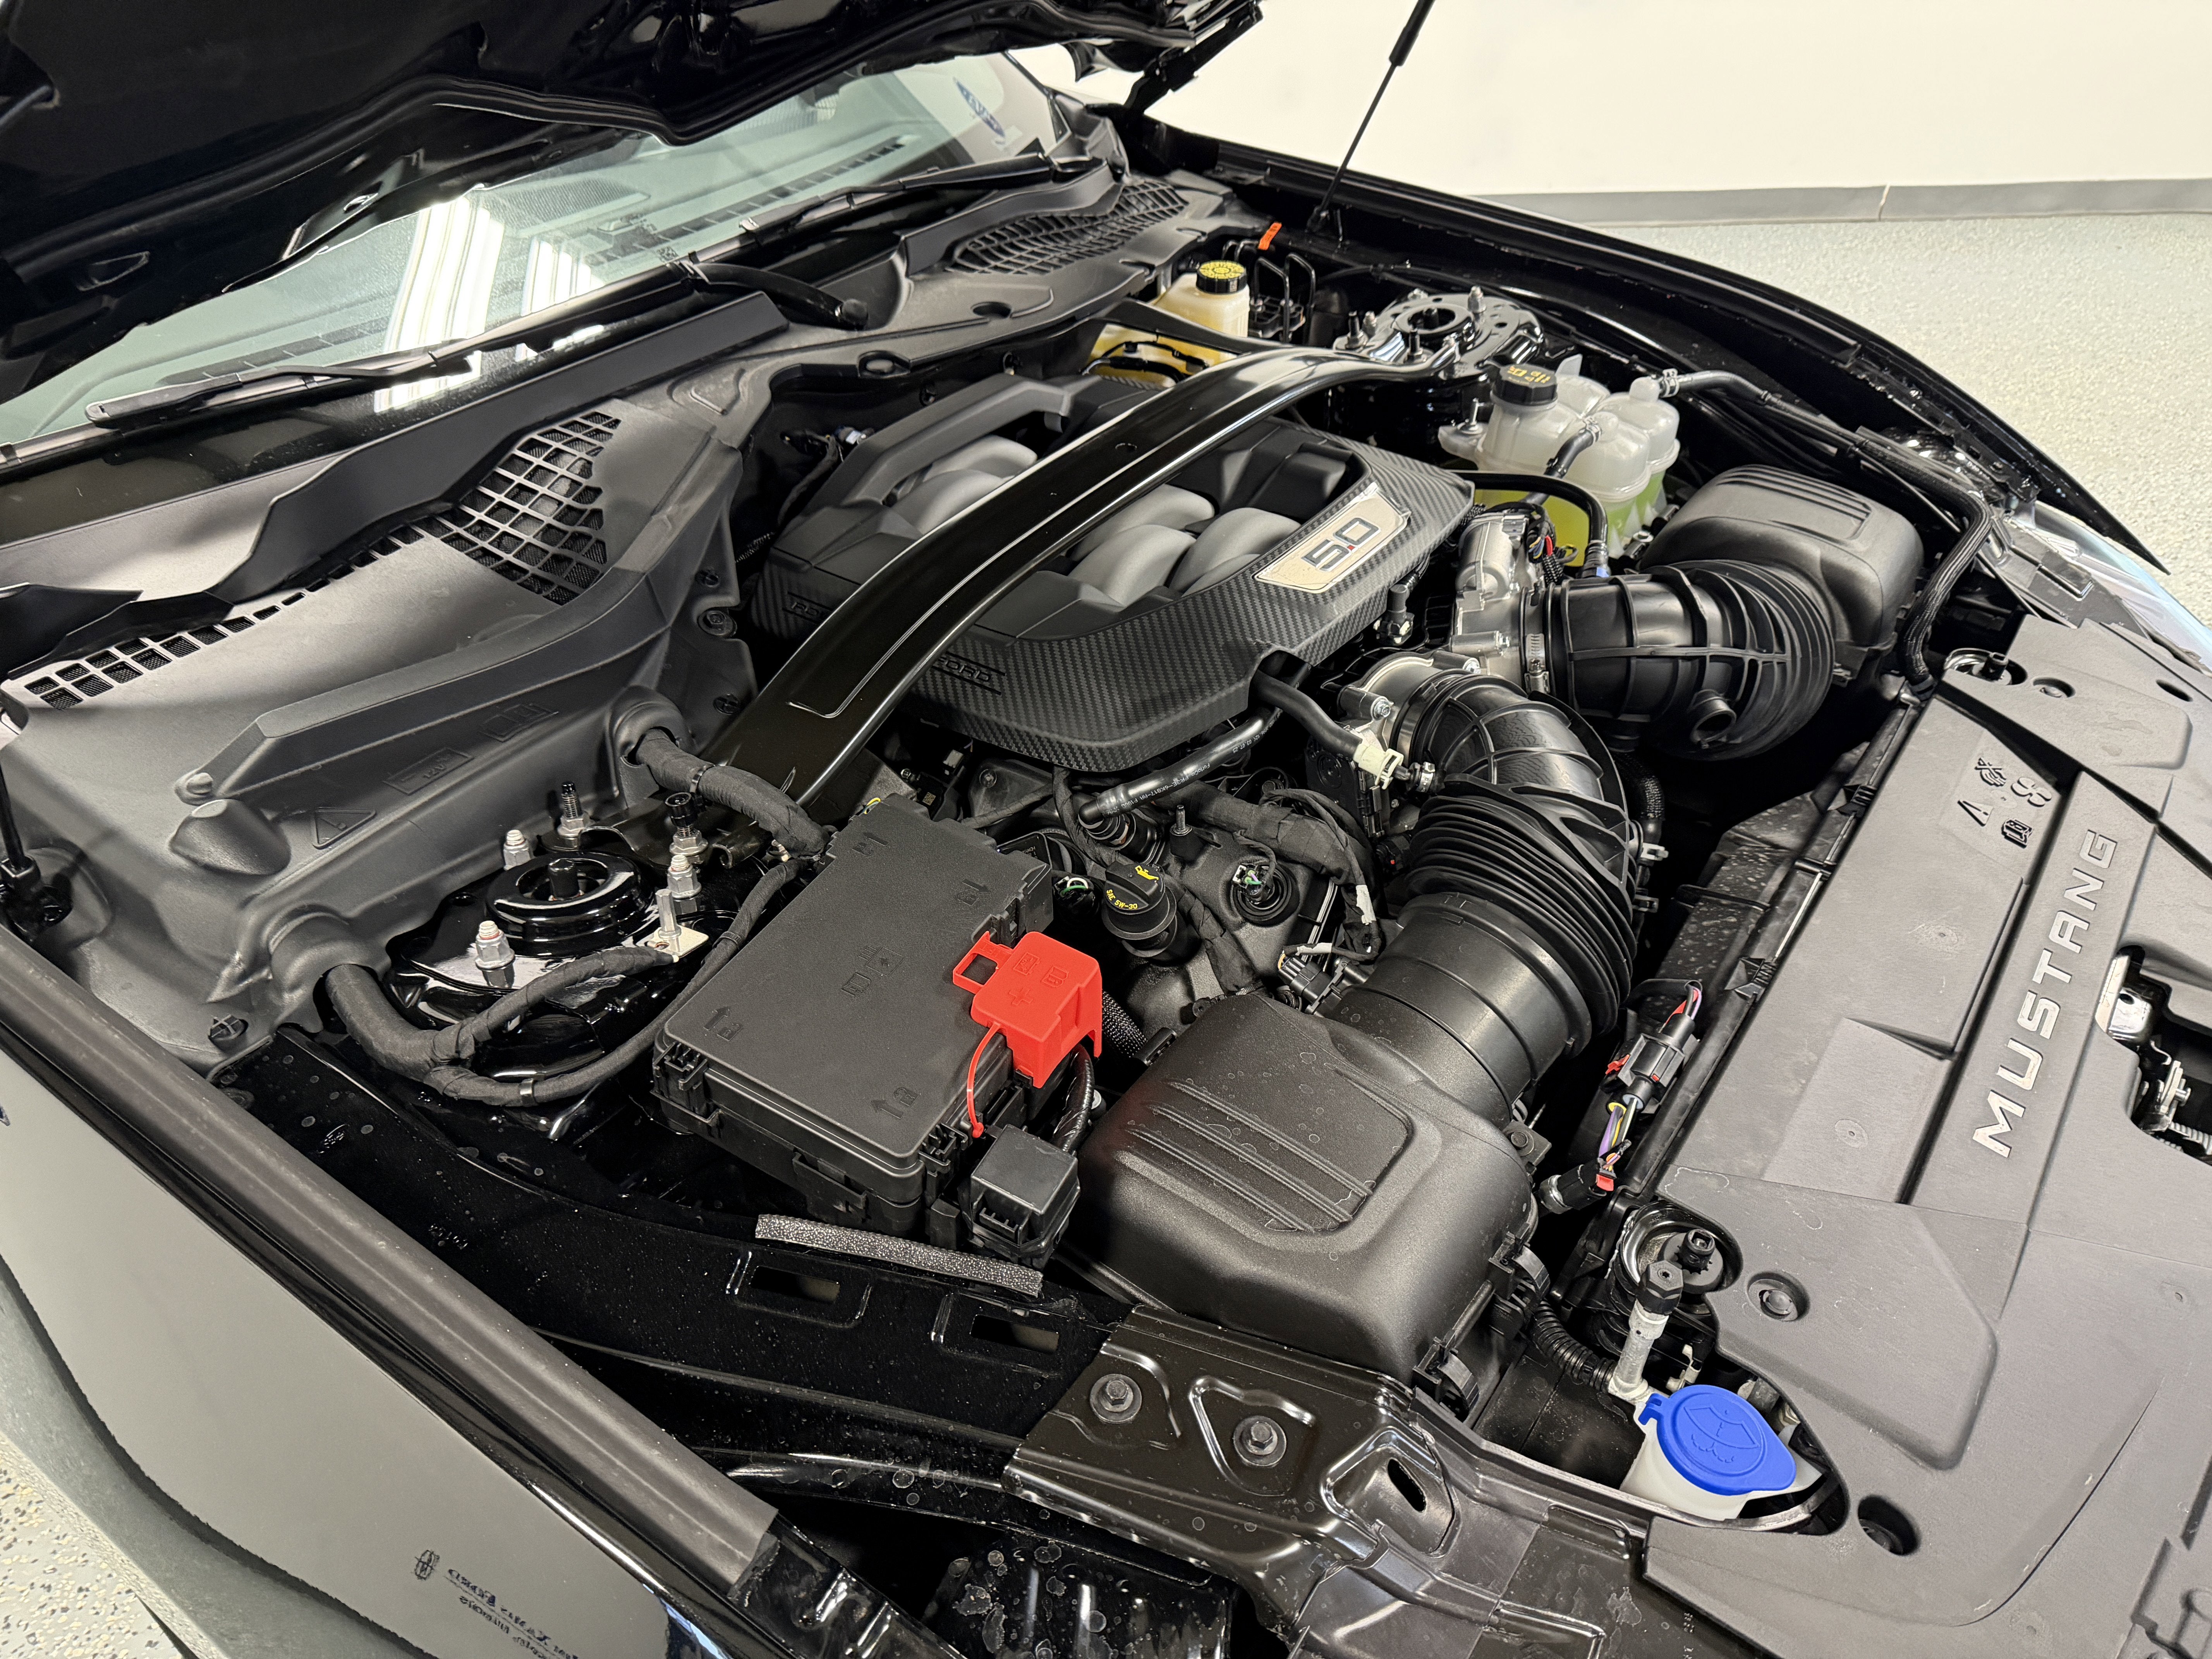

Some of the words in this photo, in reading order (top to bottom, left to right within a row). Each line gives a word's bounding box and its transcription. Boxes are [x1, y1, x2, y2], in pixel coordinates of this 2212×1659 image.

[1301, 517, 1381, 572] 5.0
[1106, 889, 1116, 901] SAE
[1114, 900, 1138, 909] 5W-30
[1972, 829, 2118, 1158] MUSTANG
